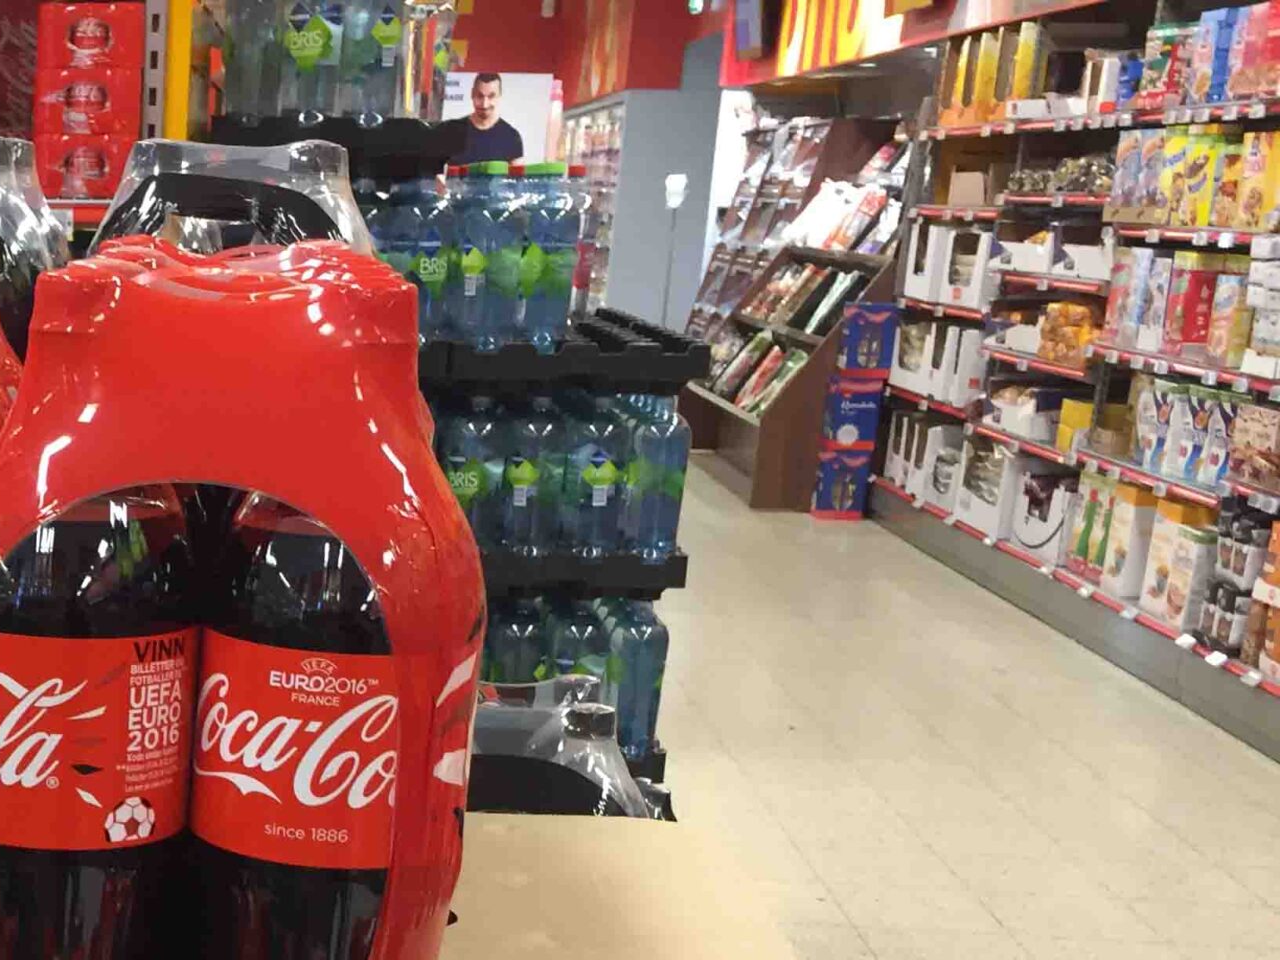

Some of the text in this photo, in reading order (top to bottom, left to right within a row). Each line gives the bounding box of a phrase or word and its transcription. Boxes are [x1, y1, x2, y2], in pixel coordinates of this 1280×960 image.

[133, 637, 185, 662] VINN
[129, 680, 183, 709] UEFA
[290, 692, 341, 707] FRANCE
[128, 701, 182, 731] EURO
[126, 725, 180, 753] 2016
[263, 823, 349, 844] since 1886
